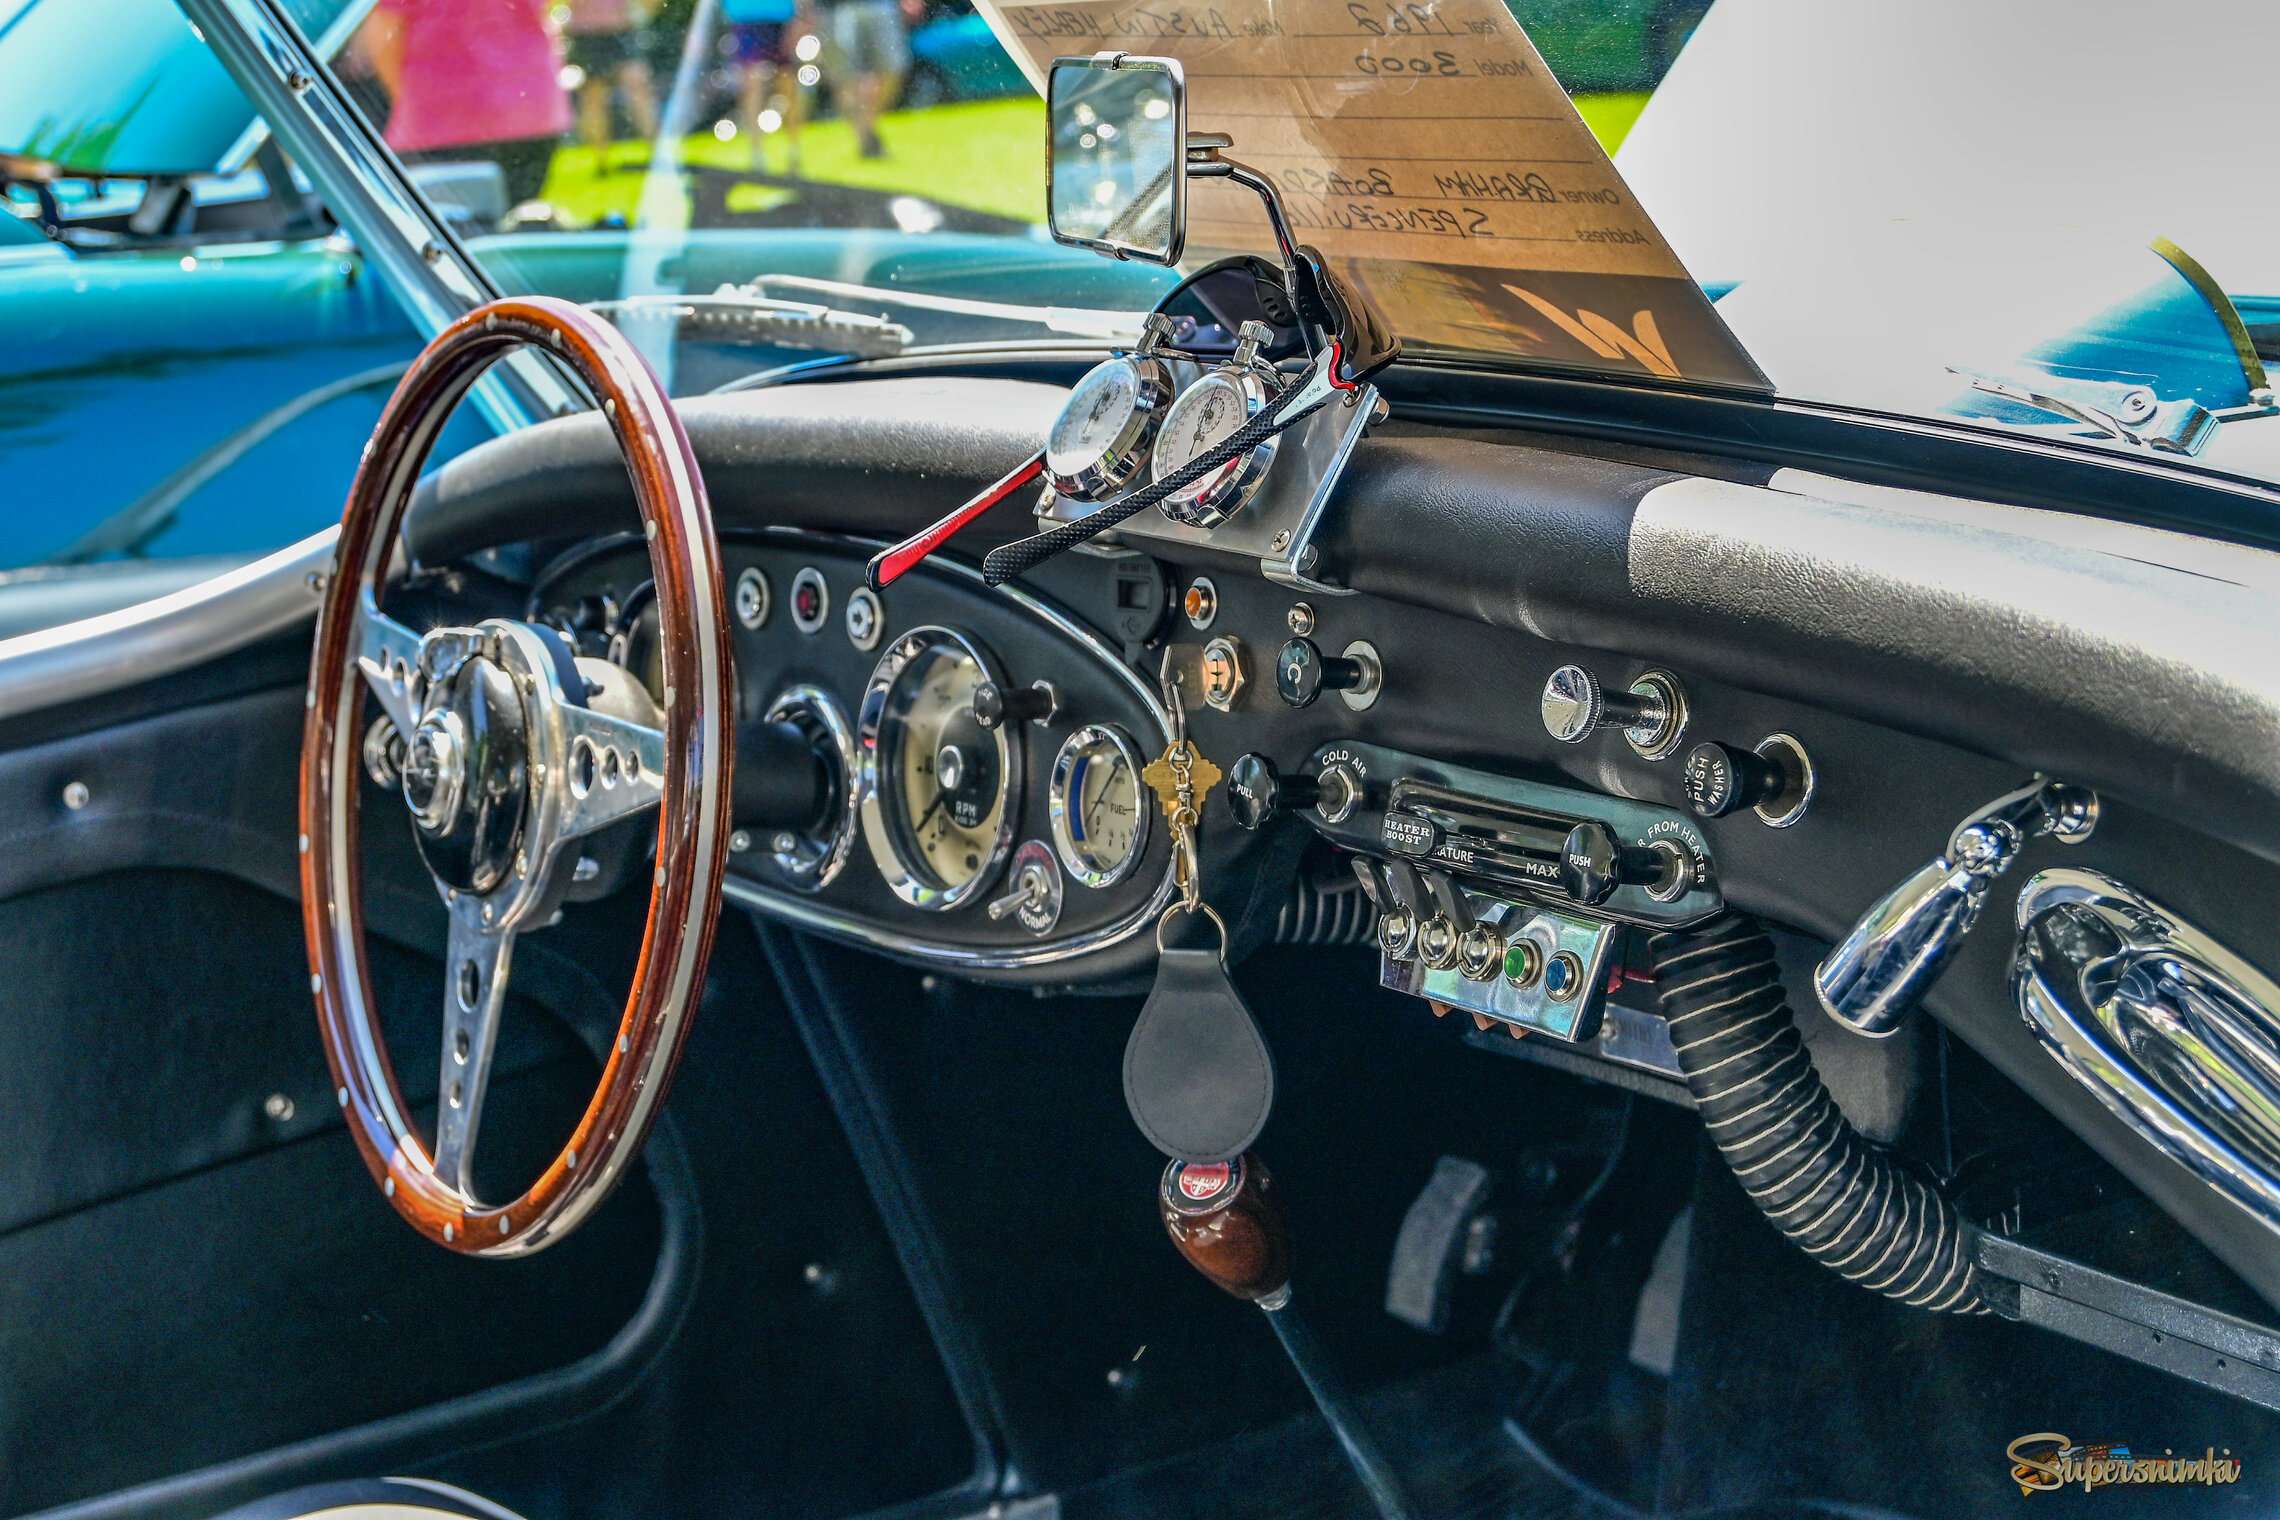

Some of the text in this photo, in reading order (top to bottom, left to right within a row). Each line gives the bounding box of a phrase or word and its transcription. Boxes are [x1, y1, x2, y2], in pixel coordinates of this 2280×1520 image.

[1322, 750, 1368, 777] COLD AIR
[1694, 757, 1709, 803] PUSH
[1707, 760, 1725, 805] WASHER
[1236, 783, 1253, 799] PULL
[955, 800, 976, 817] RPM
[1110, 803, 1127, 816] FUEL
[1384, 819, 1431, 838] HEATER
[1385, 830, 1422, 846] BOOST
[1568, 853, 1592, 868] PUSH
[1647, 821, 1706, 884] FROM HEATER
[1525, 862, 1560, 879] MAX
[1018, 905, 1052, 929] NORMAL
